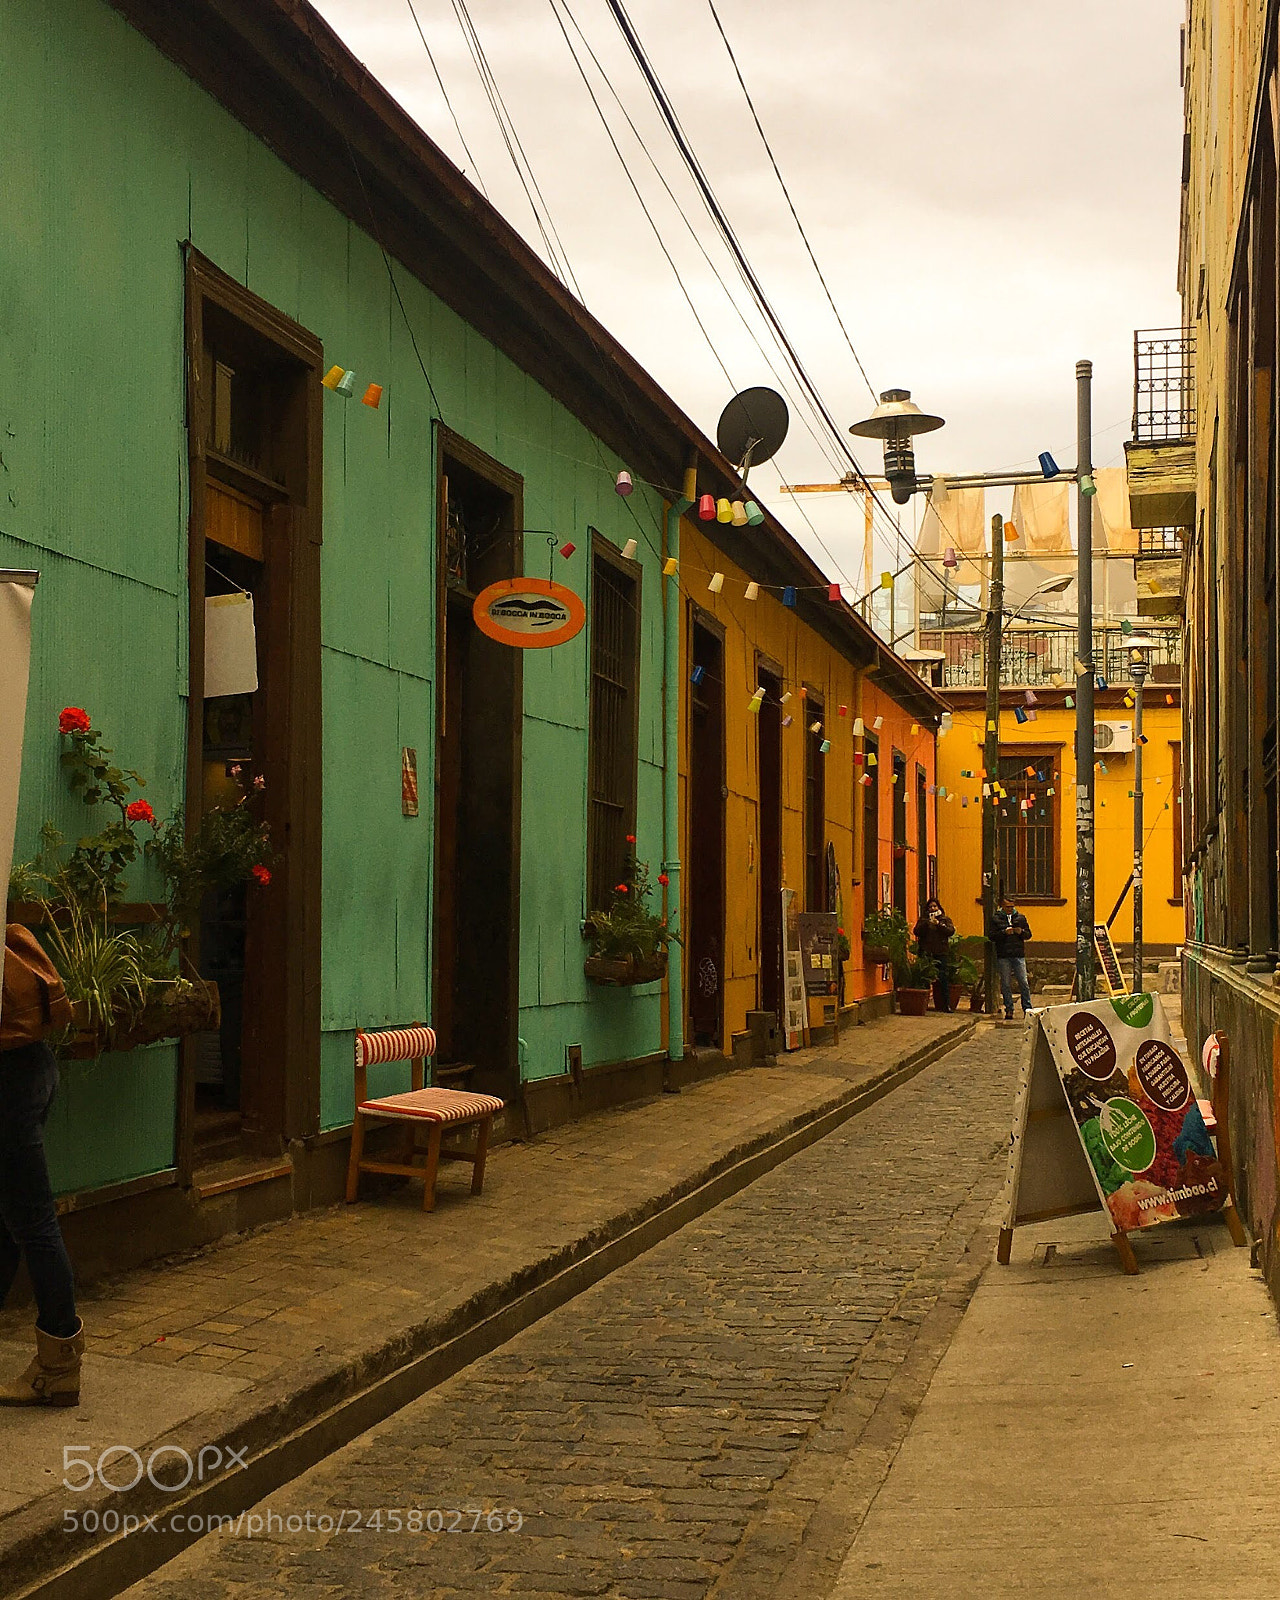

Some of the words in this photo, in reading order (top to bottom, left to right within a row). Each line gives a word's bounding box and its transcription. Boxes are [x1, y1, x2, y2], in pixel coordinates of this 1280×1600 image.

[500, 609, 528, 618] BOCCA
[529, 611, 538, 619] IN
[539, 612, 567, 620] BOCCA
[1074, 1023, 1094, 1041] RECETAS
[1074, 1028, 1103, 1052] ARTESANALES
[1077, 1050, 1088, 1061] QUE
[1086, 1034, 1109, 1054] ENCANTAN
[1084, 1057, 1092, 1067] TU
[1122, 1113, 1137, 1129] LECHE
[1109, 1138, 1122, 1152] BAJO
[1120, 1118, 1146, 1142] CONTENIDO
[1121, 1144, 1130, 1153] DE
[1127, 1133, 1143, 1148] SODIO
[1137, 1176, 1219, 1211] www.timbao.cl
